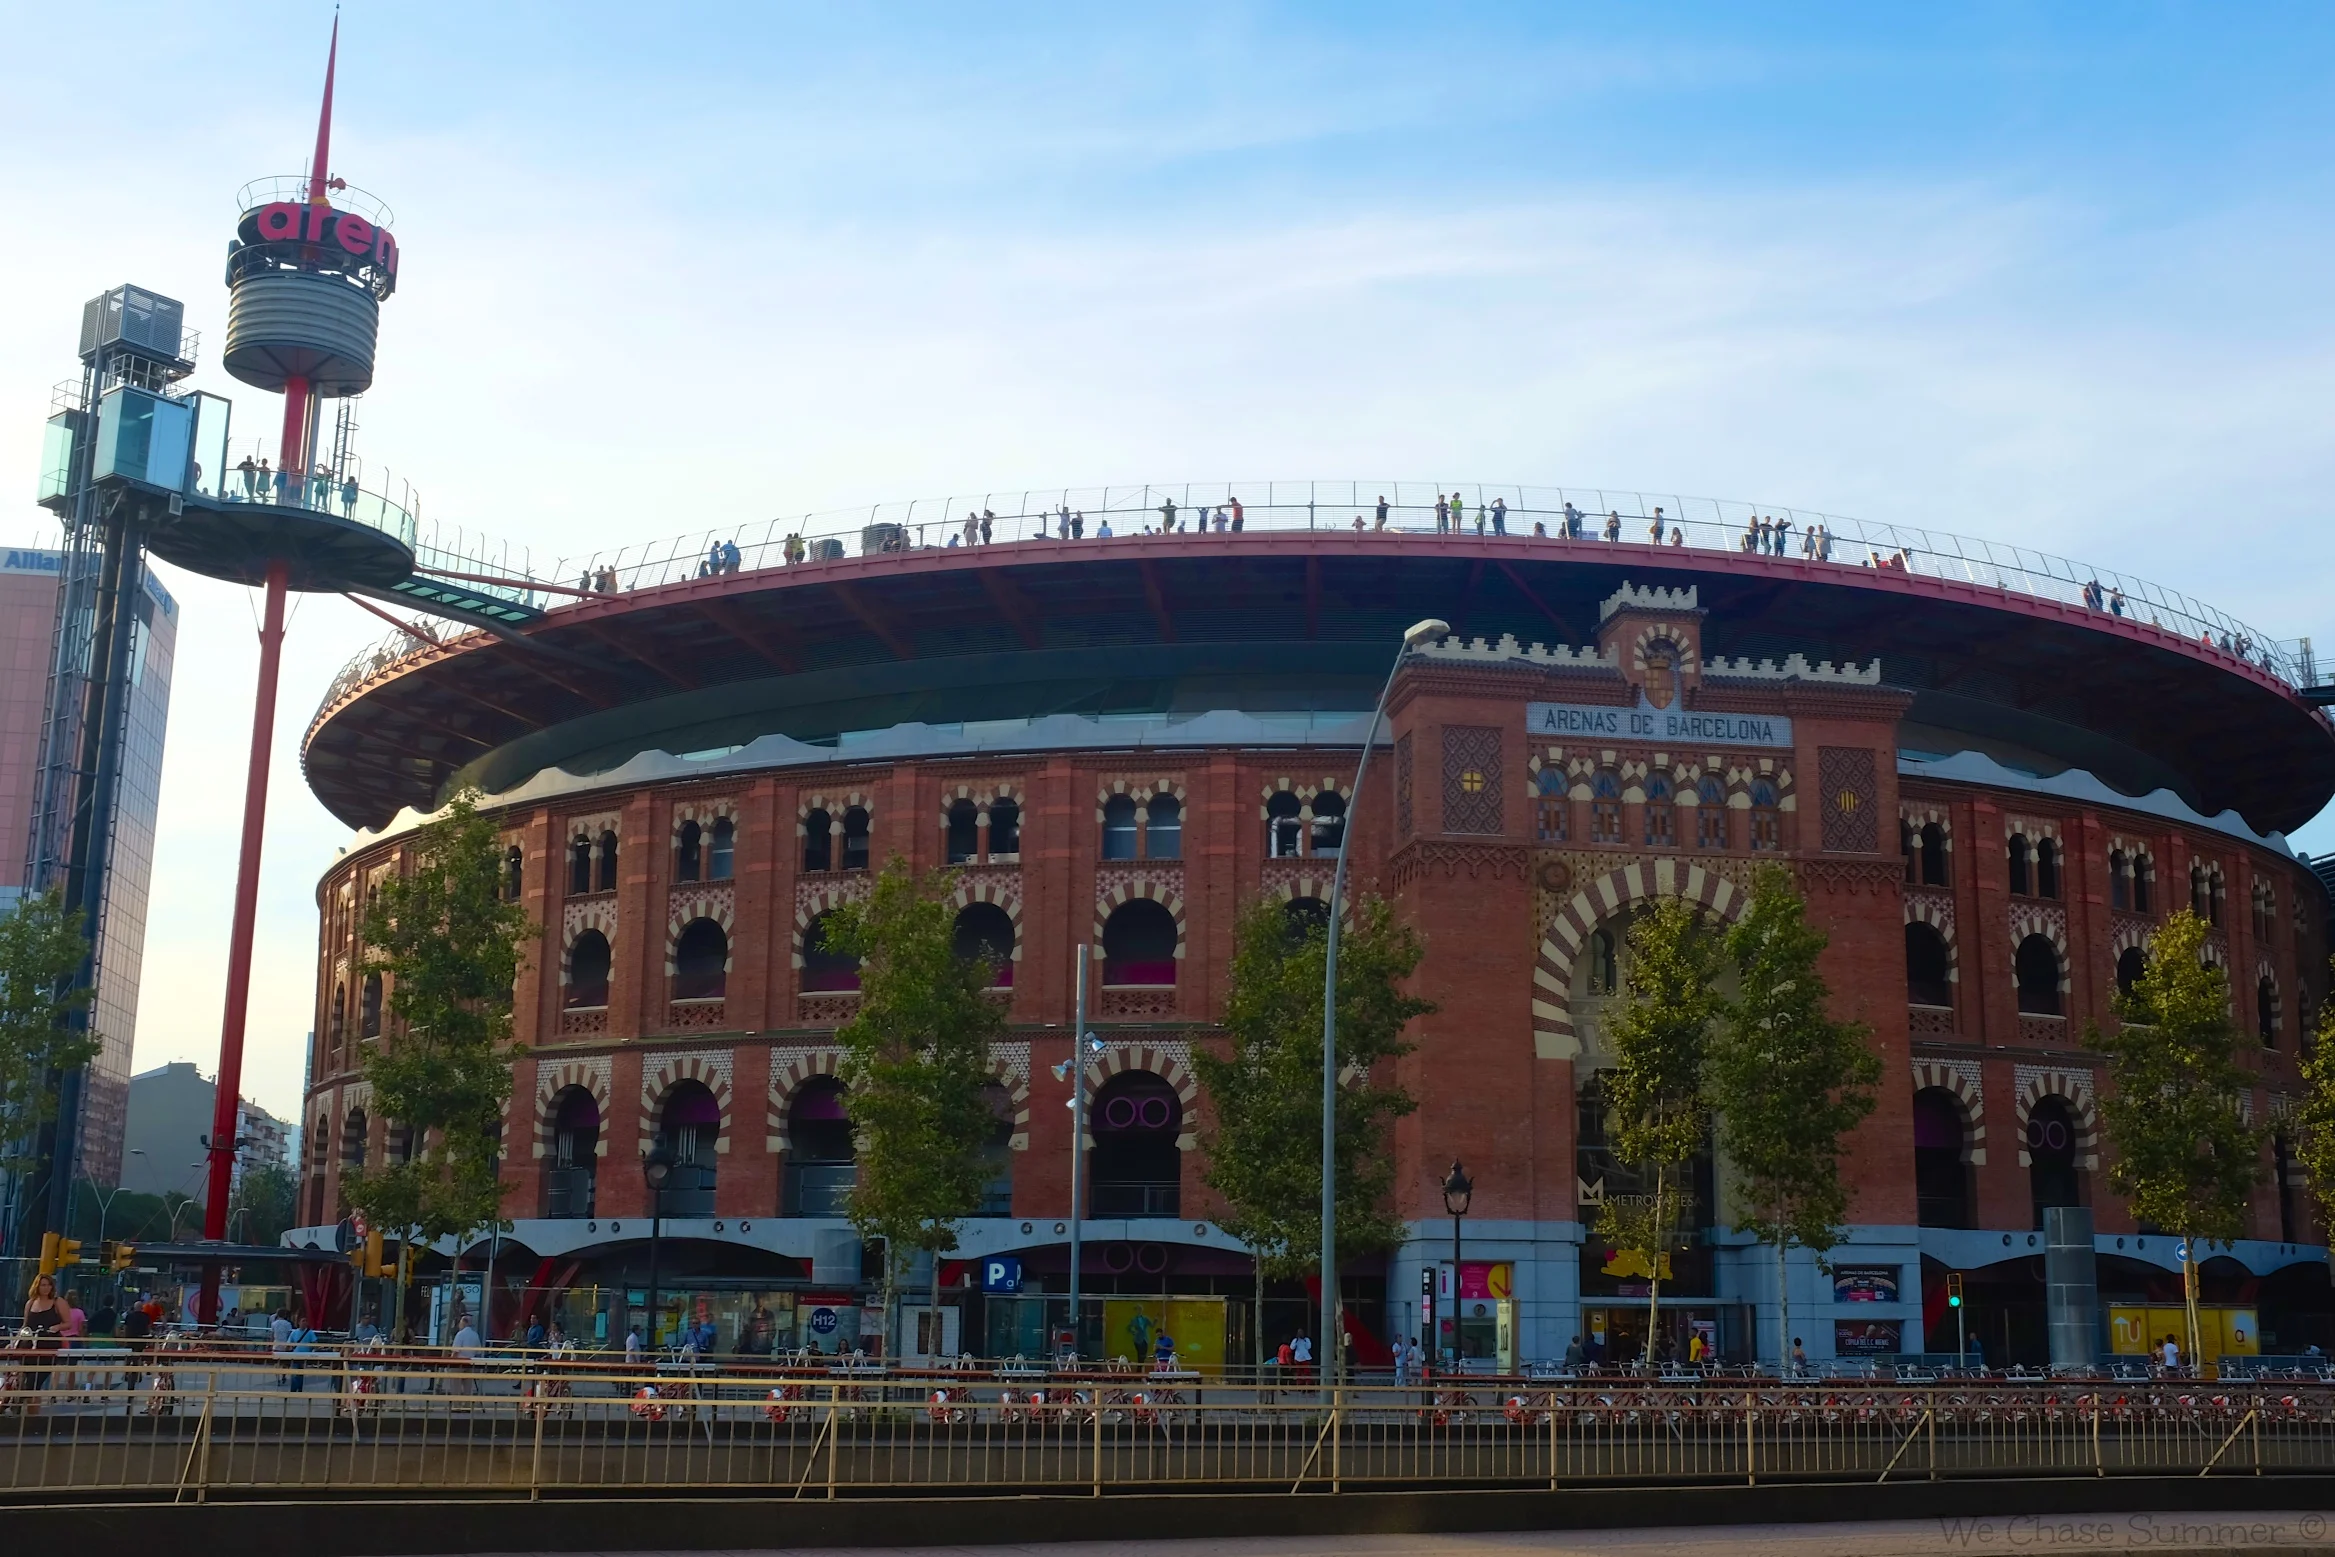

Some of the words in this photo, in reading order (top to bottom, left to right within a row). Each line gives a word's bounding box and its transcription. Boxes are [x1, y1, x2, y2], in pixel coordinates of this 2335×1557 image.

[4, 550, 62, 571] Allia
[1545, 709, 1618, 733] ARENAS
[1630, 715, 1654, 736] DE
[1666, 716, 1774, 742] BARCELONA
[1608, 1194, 1704, 1207] METROVAESA
[988, 1262, 1006, 1286] P
[813, 1314, 836, 1326] H12
